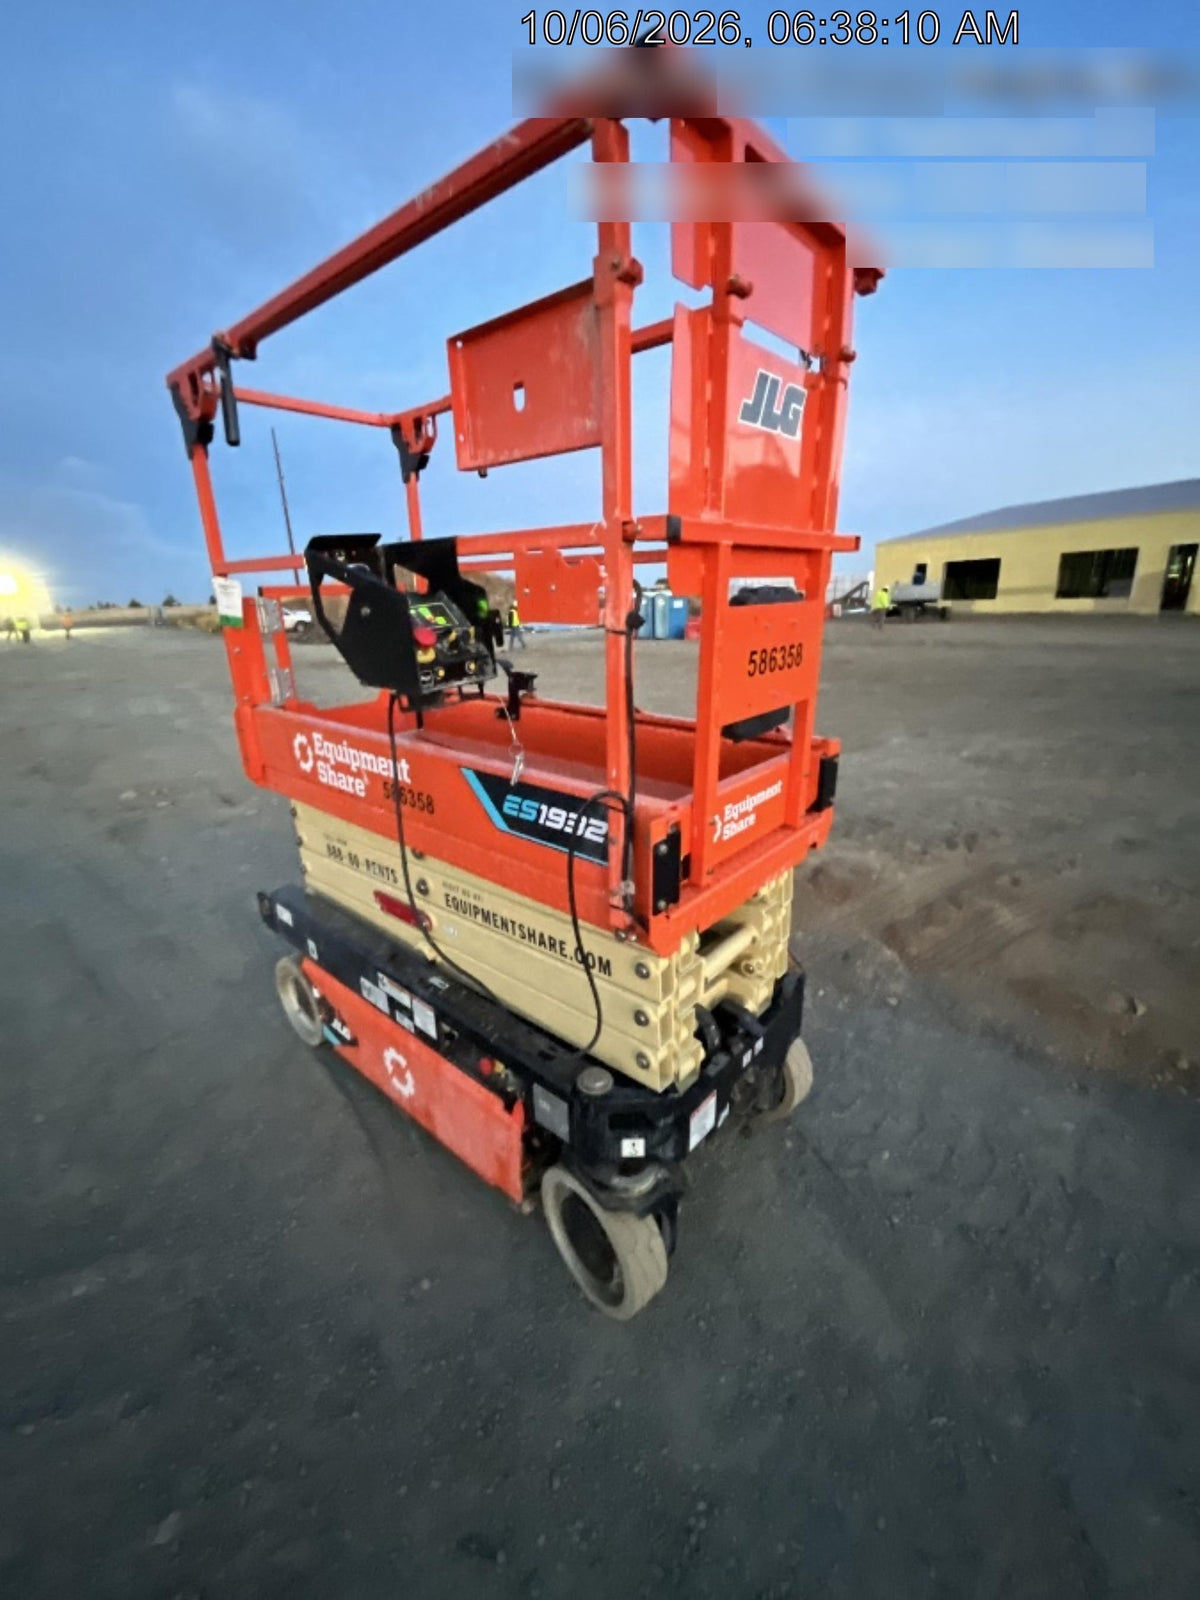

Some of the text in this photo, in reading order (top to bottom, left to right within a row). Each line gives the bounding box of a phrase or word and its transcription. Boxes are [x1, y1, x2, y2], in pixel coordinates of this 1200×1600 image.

[738, 368, 808, 440] JLG
[747, 642, 803, 677] 586358
[312, 732, 411, 784] Equipment
[316, 760, 366, 797] Share
[724, 779, 783, 822] Equipment
[722, 813, 756, 841] Share
[445, 894, 612, 976] EQUIPMENTSHARE.COM
